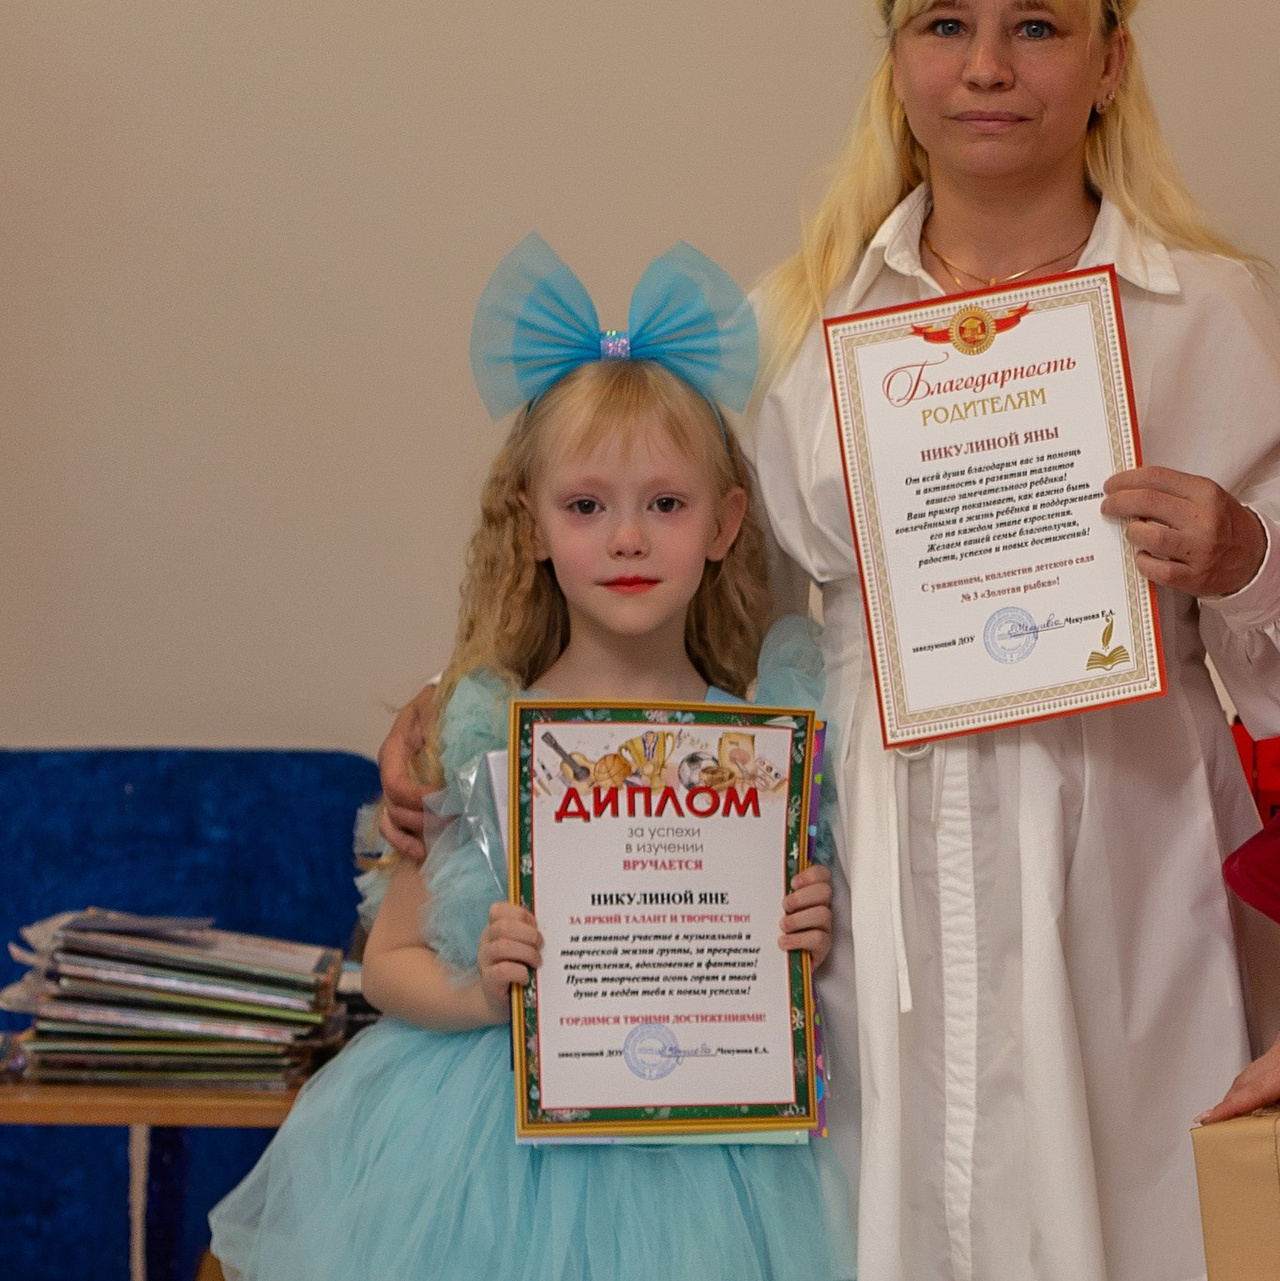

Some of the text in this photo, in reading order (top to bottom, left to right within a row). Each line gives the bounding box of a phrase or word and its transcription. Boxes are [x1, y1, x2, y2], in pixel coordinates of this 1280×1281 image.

[881, 351, 1077, 408] Благодарность
[920, 387, 1046, 426] РОДИТЕЛЯМ
[920, 426, 1059, 462] НИКУЛИНОЙ ЯНЫ
[905, 448, 1081, 485] От всей души благодарим вас за помощь
[922, 479, 976, 494] активность
[984, 469, 1027, 485] развитии
[1029, 461, 1074, 475] талантов
[906, 511, 925, 520] Ваш
[928, 505, 959, 518] пример
[1017, 488, 1033, 501] как
[1035, 485, 1064, 498] важно
[1066, 482, 1089, 492] быть
[925, 493, 956, 505] вашего
[957, 481, 1027, 500] замечательного
[965, 511, 994, 522] жизнь
[1039, 492, 1103, 509] поддерживать
[929, 532, 943, 540] его
[957, 523, 992, 535] каждом
[995, 518, 1021, 528] этапе
[926, 540, 961, 552] Желаем
[963, 534, 990, 546] вашей
[992, 530, 1016, 541] семье
[959, 547, 992, 561] успехов
[1002, 539, 1028, 551] новых
[985, 566, 1032, 581] коллектив
[1034, 558, 1073, 572] детского
[1075, 554, 1094, 563] сада
[555, 786, 760, 822] ДИПЛОМ
[628, 827, 700, 839] за успехи
[625, 843, 703, 854] в изучении
[623, 859, 702, 870] ВРУЧАЕТСЯ
[590, 891, 729, 906] НИКУЛИНОЙ ЯНЕ
[569, 916, 581, 924] ЗА
[584, 914, 621, 924] ЯРКИЙ
[624, 914, 666, 923] ТАЛАНТ
[581, 934, 629, 942] активное
[630, 933, 672, 942] участие
[681, 932, 742, 942] музыкальной
[560, 946, 618, 957] творческой
[706, 947, 760, 956] прекрасные
[635, 960, 694, 968] вдохновение
[566, 974, 598, 985] Пусть
[600, 975, 660, 984] творчества
[662, 974, 687, 982] огонь
[690, 974, 718, 983] горит
[728, 972, 756, 981] твоей
[573, 989, 598, 999] душе
[641, 986, 665, 996] тебя
[559, 1015, 620, 1025] ГОРДИМСЯ
[623, 1014, 669, 1024] ТВОИМИ
